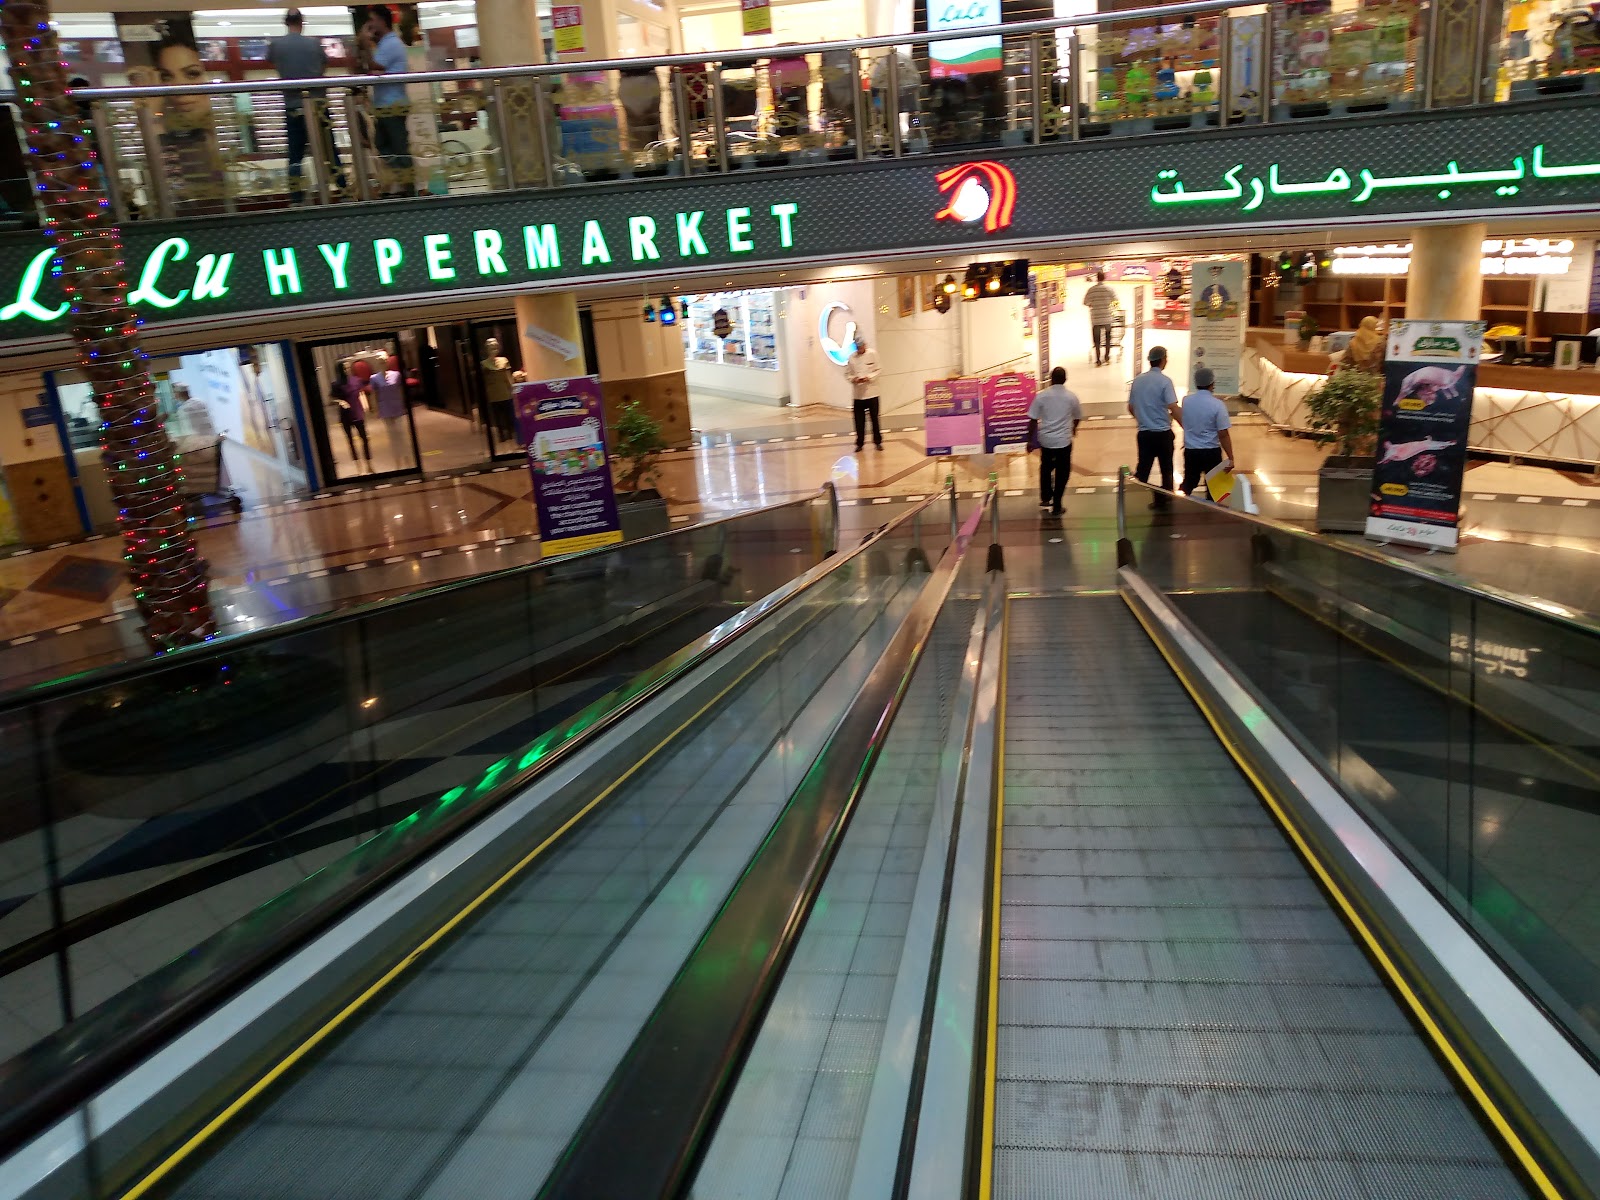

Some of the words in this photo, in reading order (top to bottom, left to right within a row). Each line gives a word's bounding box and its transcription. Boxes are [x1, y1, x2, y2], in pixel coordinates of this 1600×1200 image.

[1150, 144, 1600, 211] ايبرماركت
[0, 237, 235, 322] LLu
[262, 202, 798, 297] HYPERMARKET
